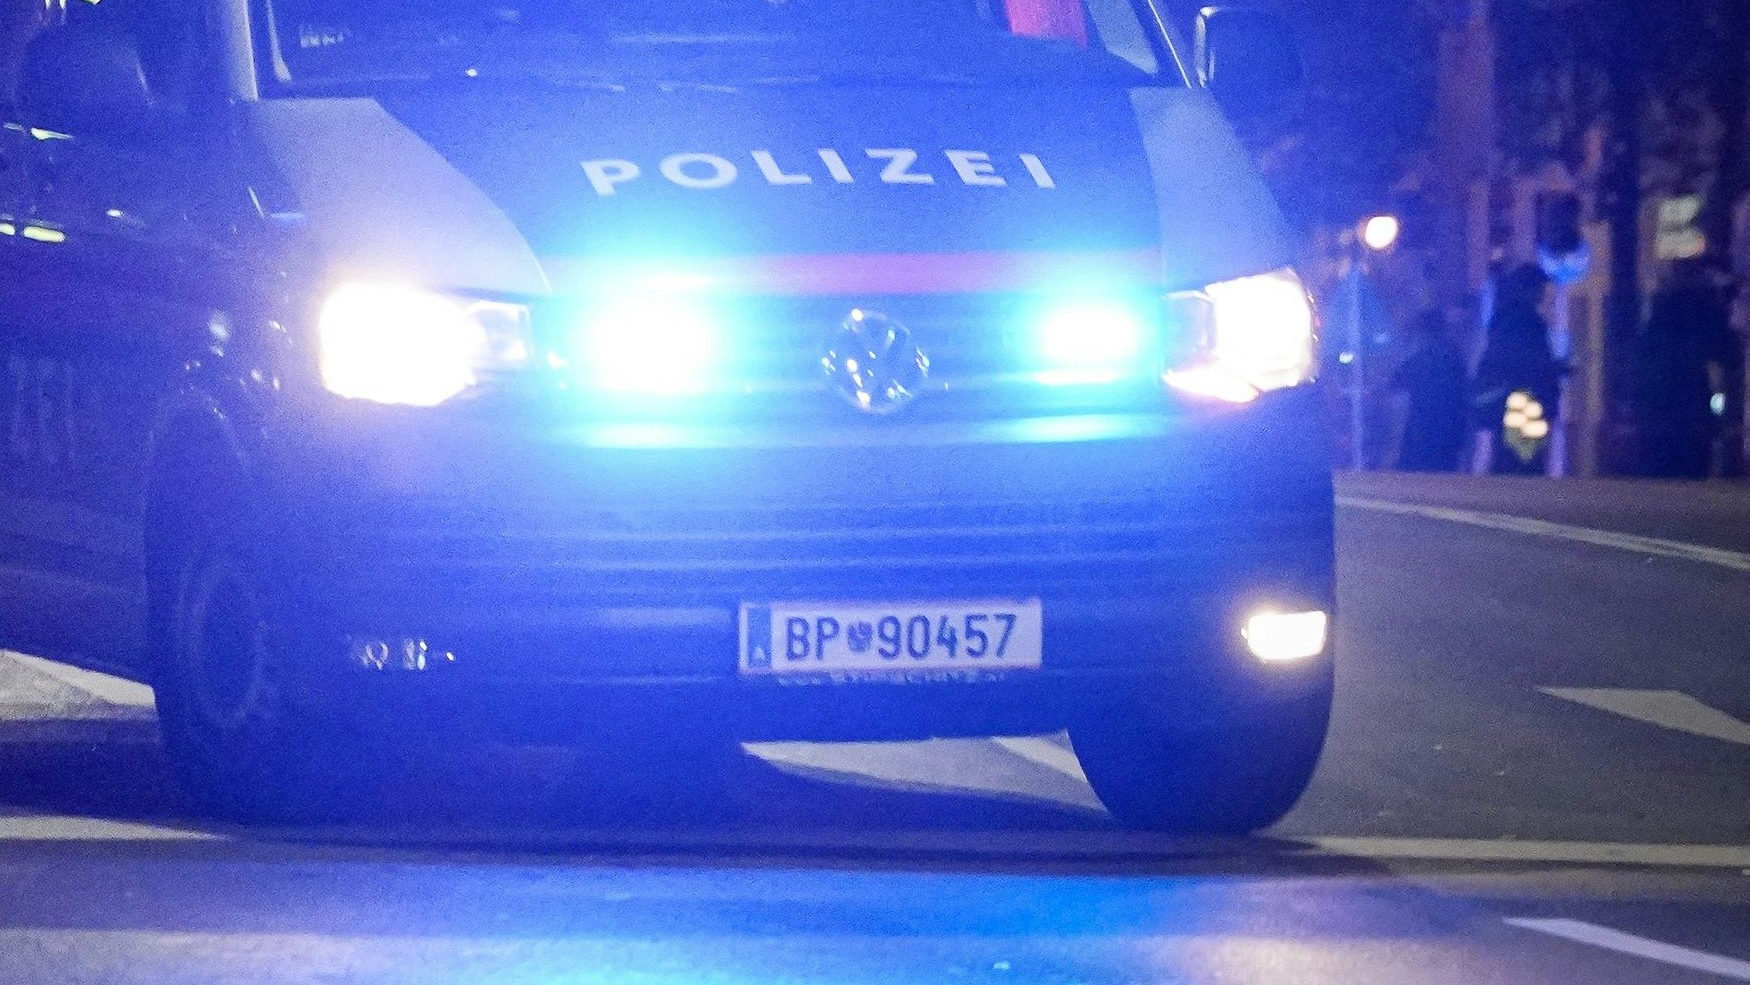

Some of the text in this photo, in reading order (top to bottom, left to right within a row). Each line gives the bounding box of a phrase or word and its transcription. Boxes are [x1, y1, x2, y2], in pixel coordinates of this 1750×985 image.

[581, 148, 1057, 197] POLIZEI
[785, 613, 1018, 662] BP 90457
